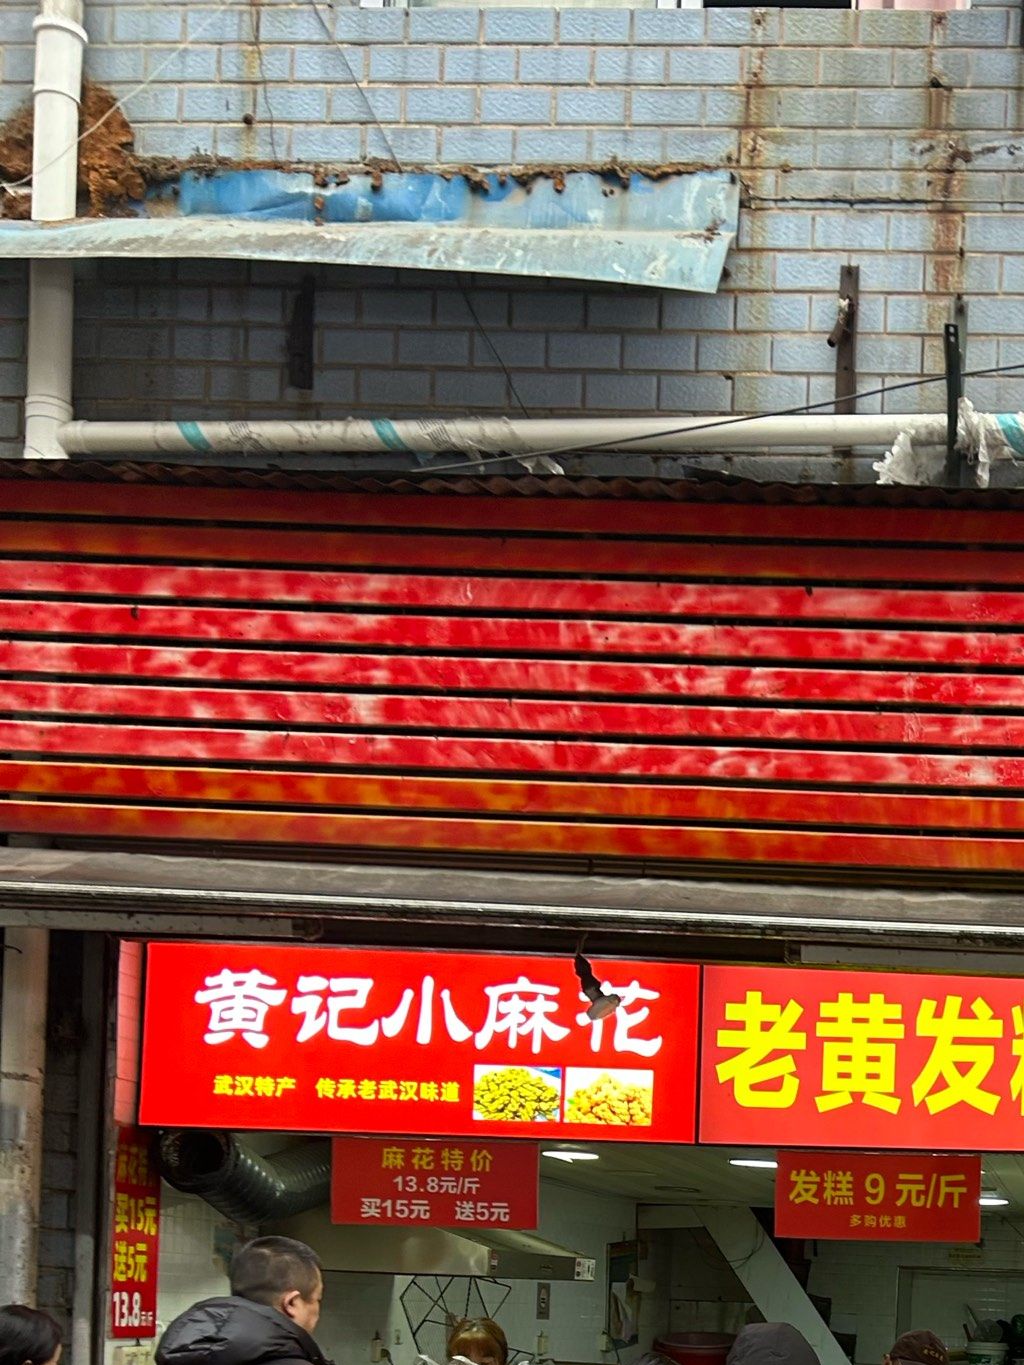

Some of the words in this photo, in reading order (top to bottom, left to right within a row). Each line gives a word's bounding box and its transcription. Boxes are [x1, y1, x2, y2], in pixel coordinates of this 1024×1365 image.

[194, 968, 663, 1058] 黄记小麻花
[212, 1074, 297, 1097] 武汉特产
[315, 1076, 461, 1104] 传承老武汉味道
[381, 1146, 493, 1172] 麻花特价
[392, 1175, 481, 1195] 13.8元/斤
[789, 1170, 854, 1206] 发糕
[865, 1173, 885, 1205] 9
[896, 1173, 967, 1209] 元/斤
[115, 1192, 158, 1236] 买15元
[360, 1198, 431, 1220] 买15元
[455, 1200, 510, 1222] 送5元
[850, 1214, 907, 1229] 多购优惠
[113, 1240, 148, 1283] 送5元
